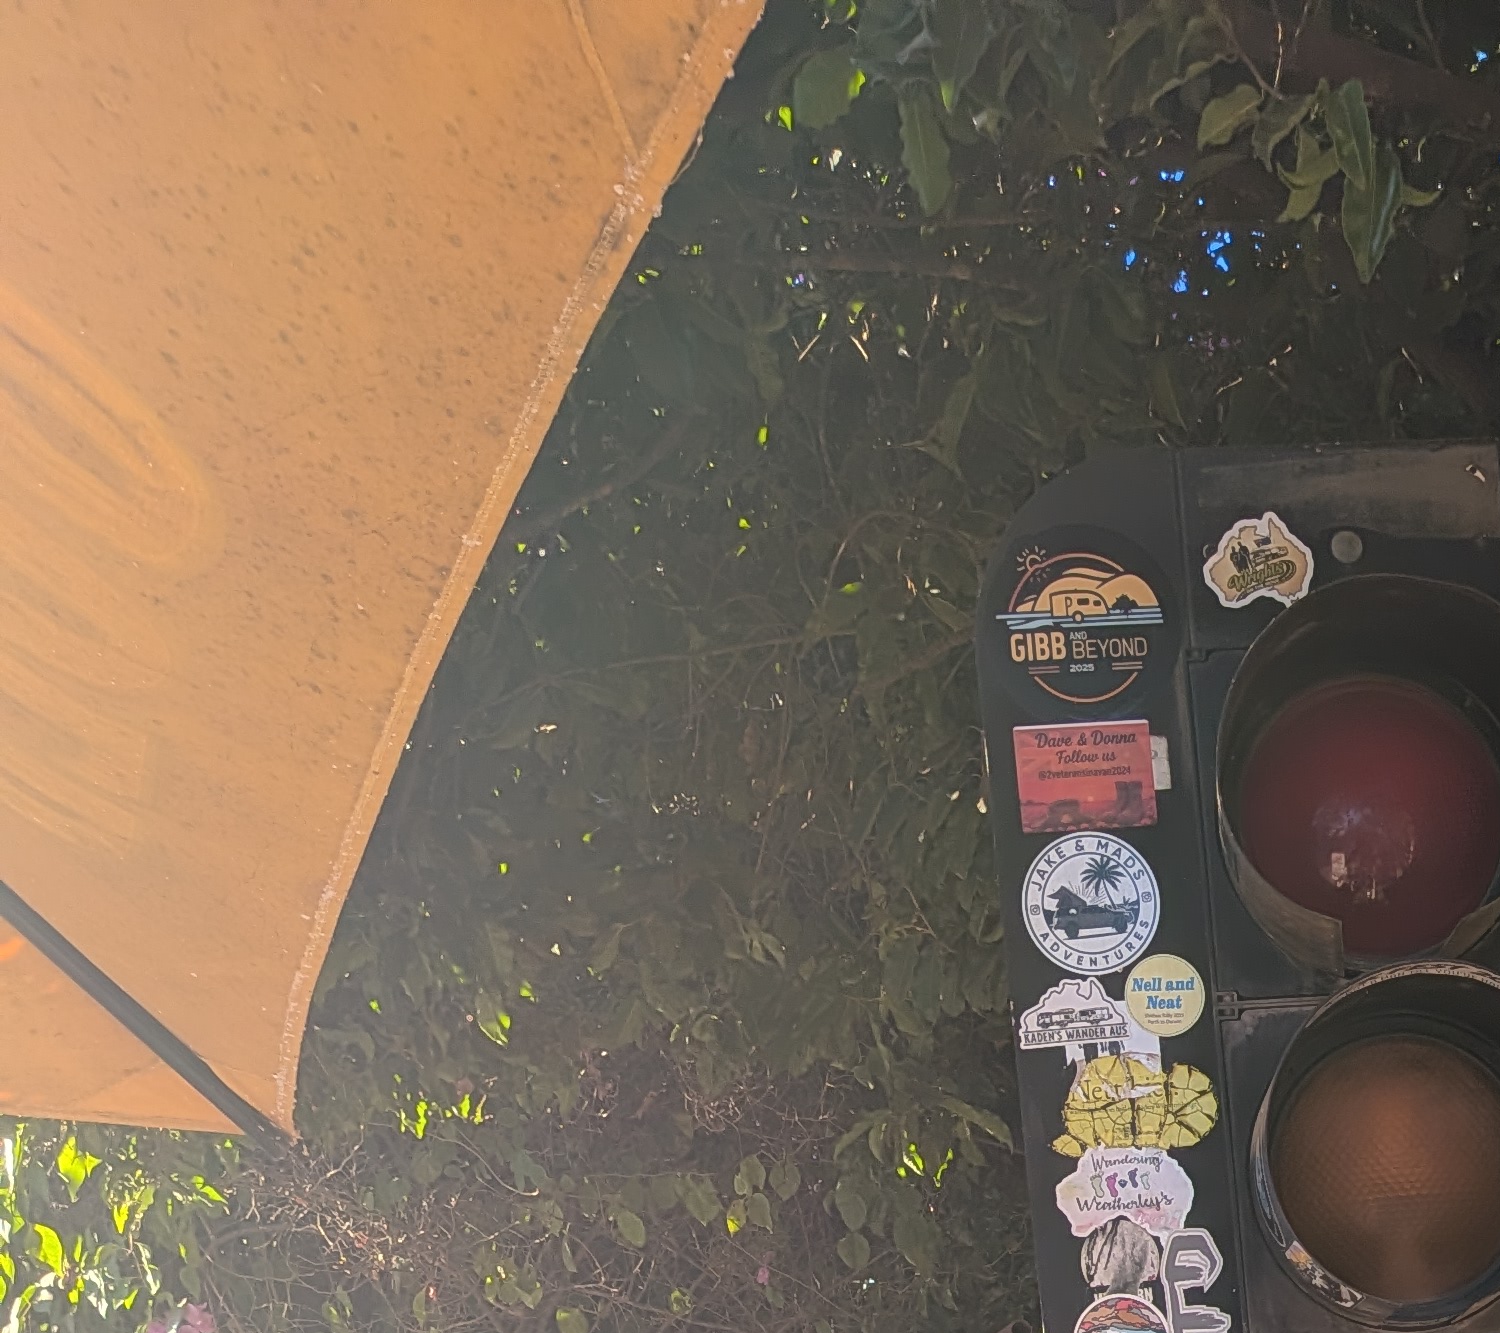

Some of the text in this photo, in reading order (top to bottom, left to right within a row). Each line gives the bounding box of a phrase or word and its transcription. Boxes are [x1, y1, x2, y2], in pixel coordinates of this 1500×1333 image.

[1011, 631, 1087, 662] GIBB AND
[1072, 637, 1148, 659] BEYOND
[1070, 664, 1095, 672] 2025
[1035, 730, 1137, 748] Dave & Donna
[1056, 750, 1116, 764] Follow us
[1031, 839, 1145, 892] JAKE & MADS
[1039, 919, 1150, 967] ADVENTURES
[1131, 976, 1195, 992] Nell and
[1146, 994, 1182, 1010] Neat
[1024, 1025, 1129, 1044] KADEN'S WANDER AUS
[1091, 1154, 1164, 1172] Wandering
[1076, 1192, 1174, 1212] Weatherley's
